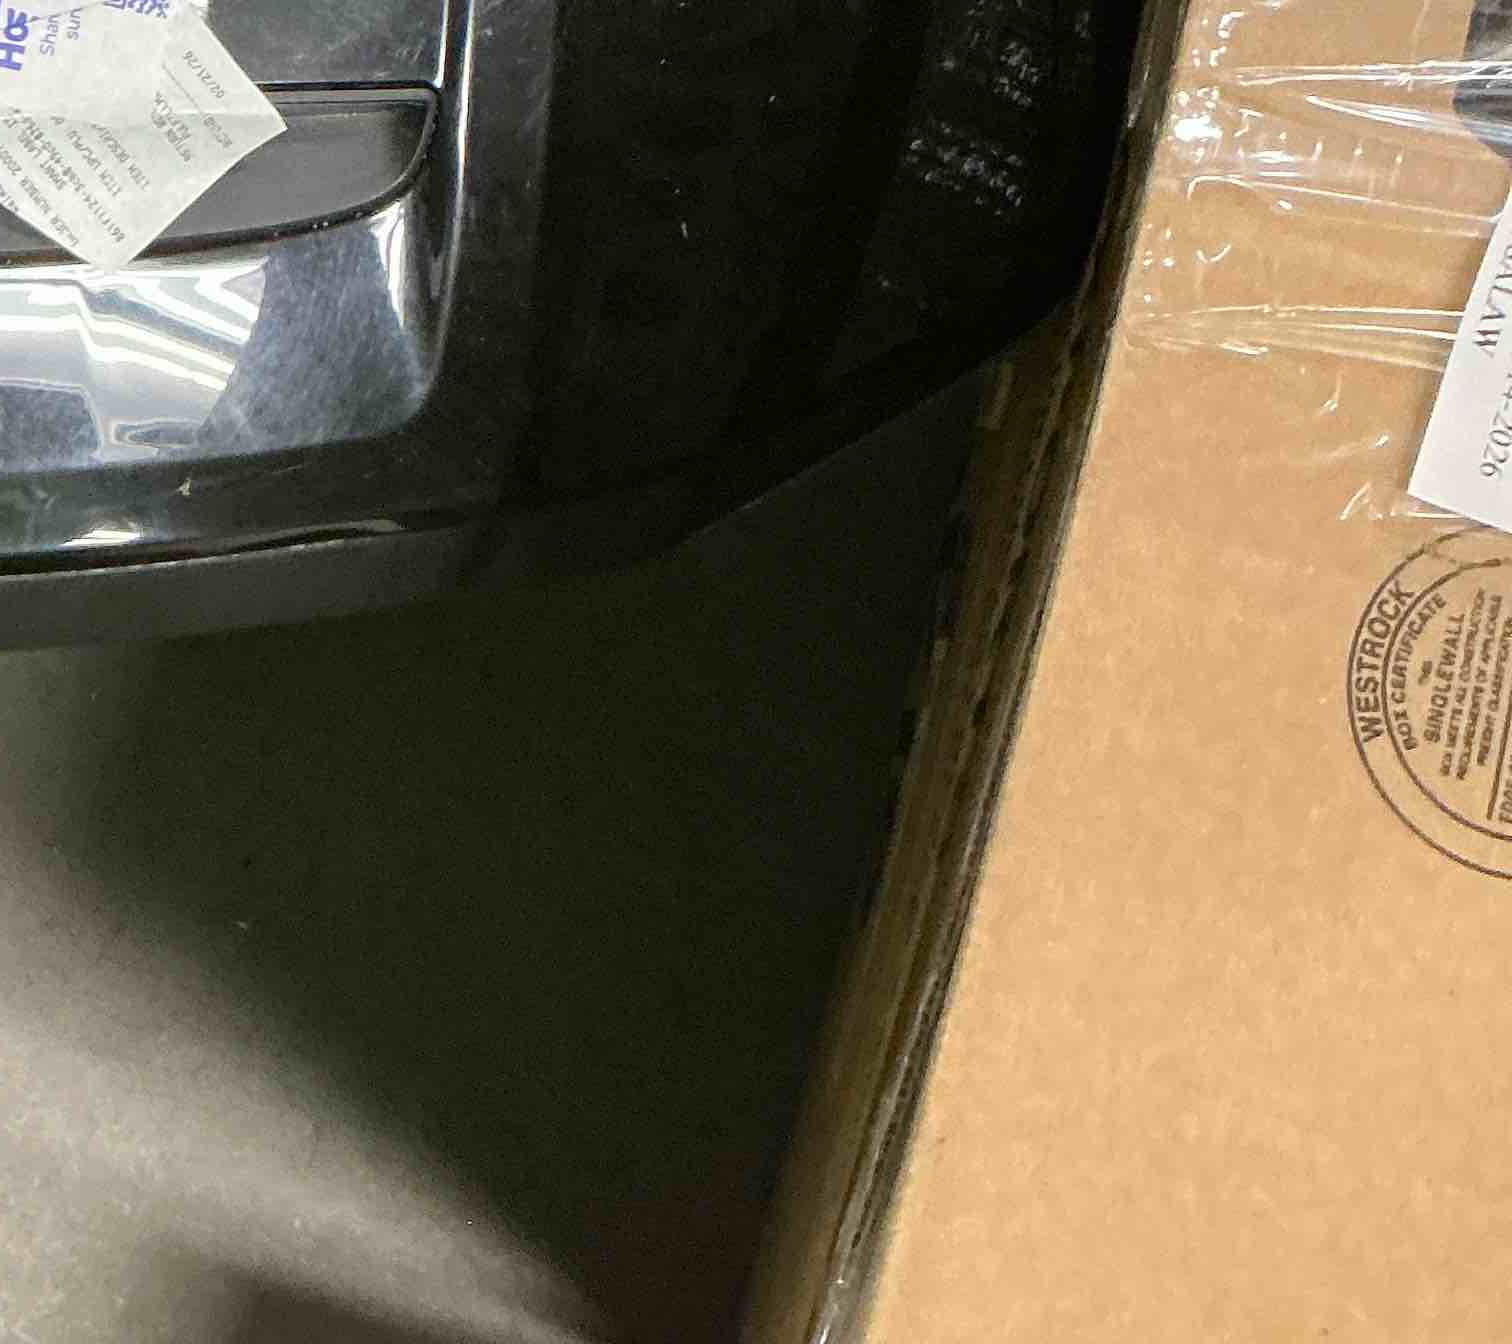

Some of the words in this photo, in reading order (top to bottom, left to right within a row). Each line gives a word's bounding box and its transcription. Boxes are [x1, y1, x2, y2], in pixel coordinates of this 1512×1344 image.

[1356, 579, 1414, 744] WESTROCK
[1391, 592, 1448, 705] CERTIFICATE
[1425, 612, 1466, 744] SINGLEWALL
